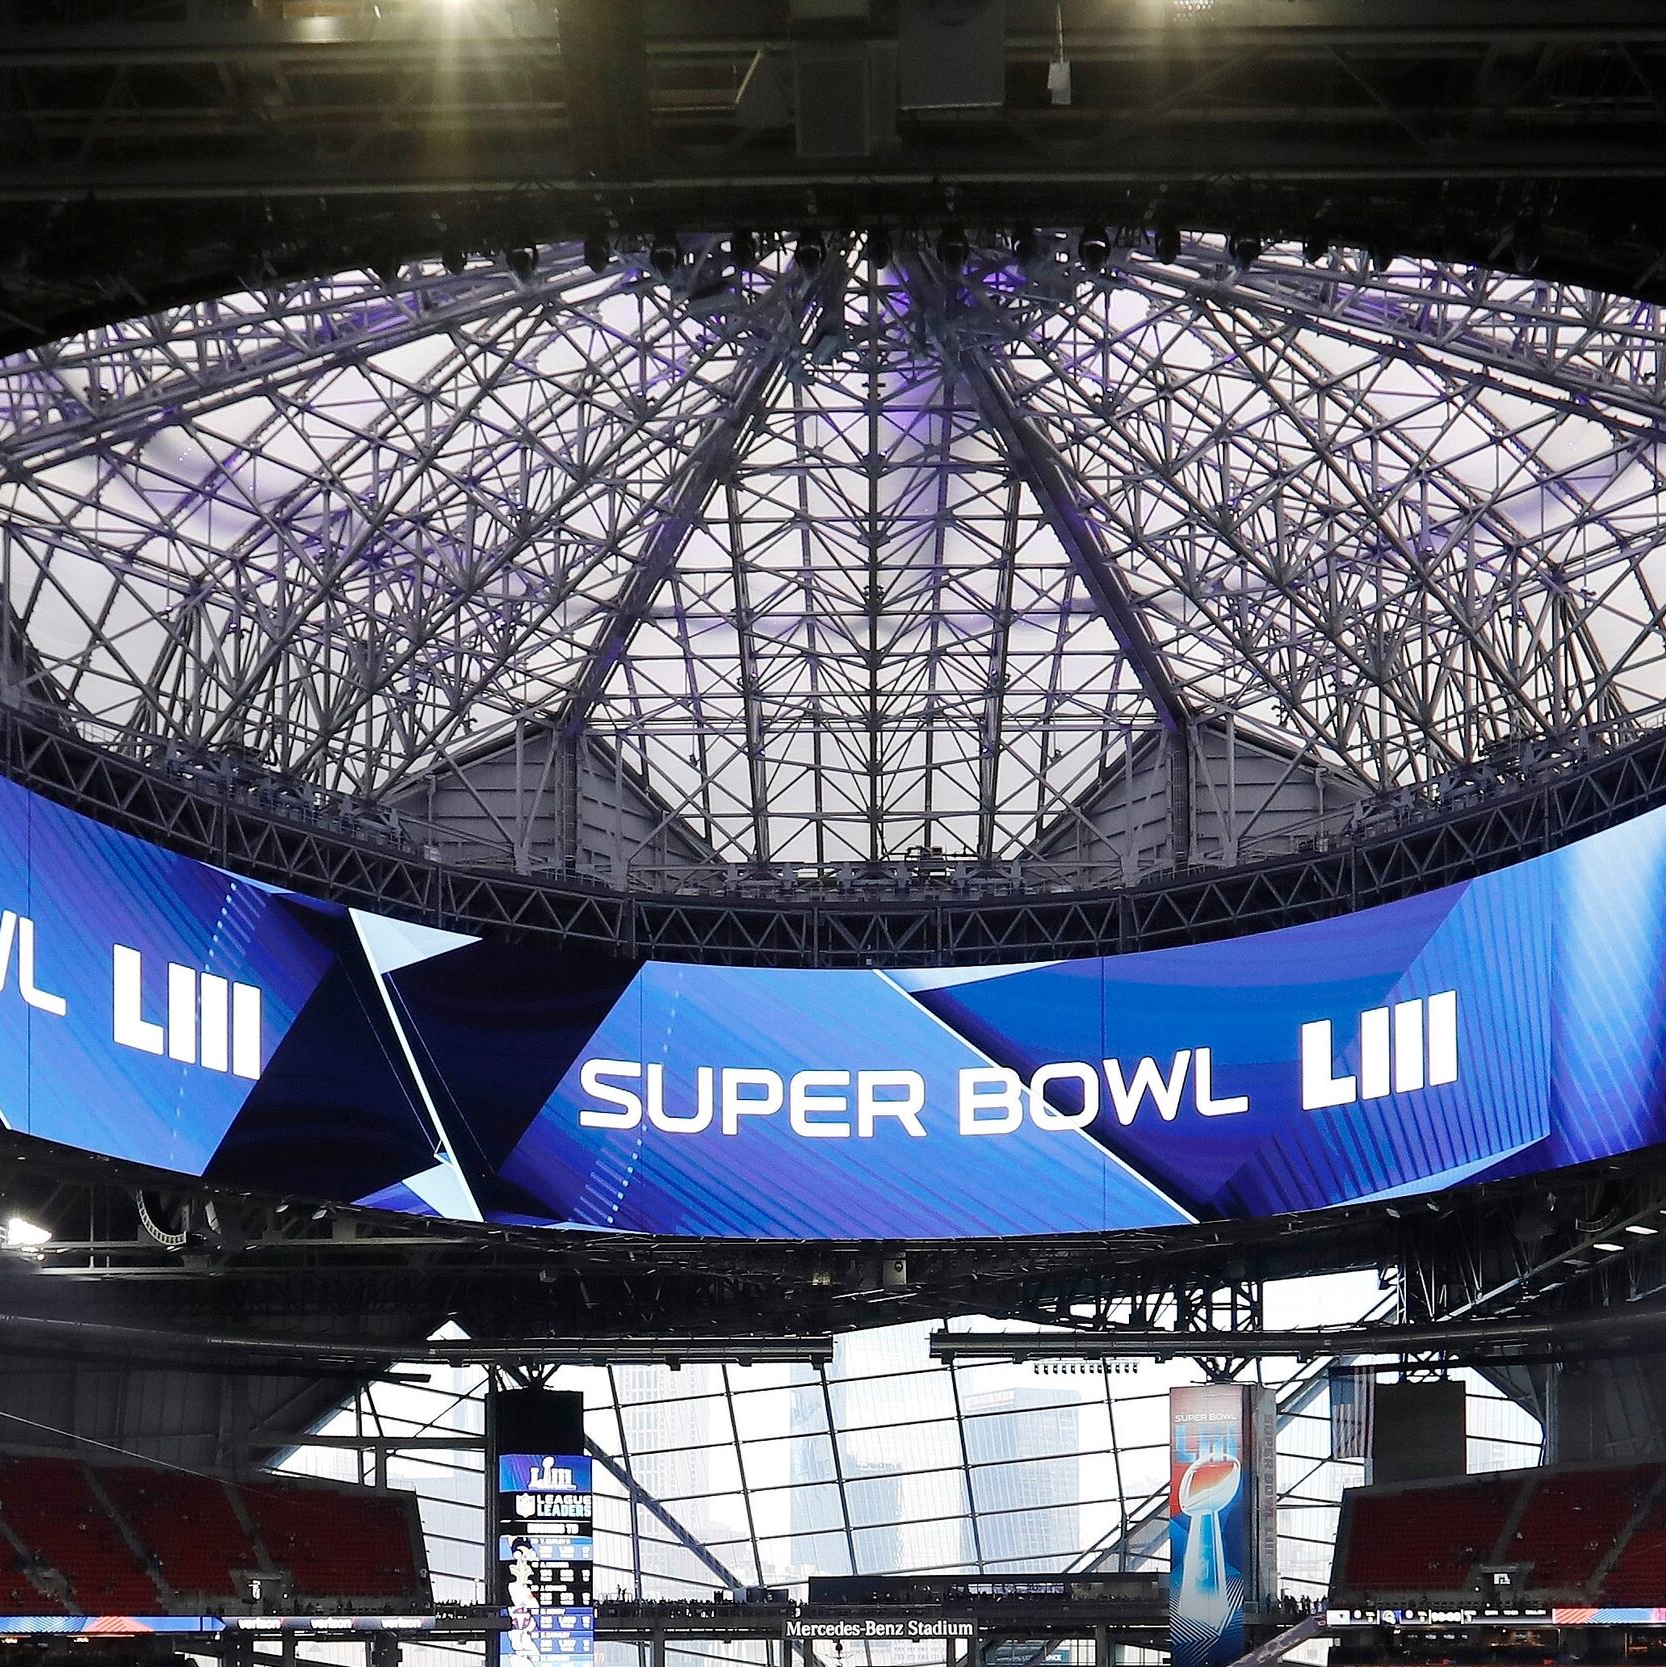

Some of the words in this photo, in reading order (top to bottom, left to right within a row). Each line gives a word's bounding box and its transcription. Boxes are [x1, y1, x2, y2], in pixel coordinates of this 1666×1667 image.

[114, 943, 262, 1080] LIII
[578, 1058, 926, 1137] SUPER
[958, 1048, 1248, 1136] BOWL
[1300, 990, 1458, 1111] LIII
[1174, 1414, 1207, 1422] SUPER
[1209, 1413, 1238, 1421] BOWL
[537, 1494, 592, 1504] LEAGUE
[537, 1504, 592, 1517] LEADERS
[237, 1617, 282, 1630] verizon
[310, 1617, 354, 1630] verizon
[381, 1616, 423, 1630] verizon
[786, 1620, 903, 1637] Mercedes-Benz
[908, 1620, 974, 1637] Stadium
